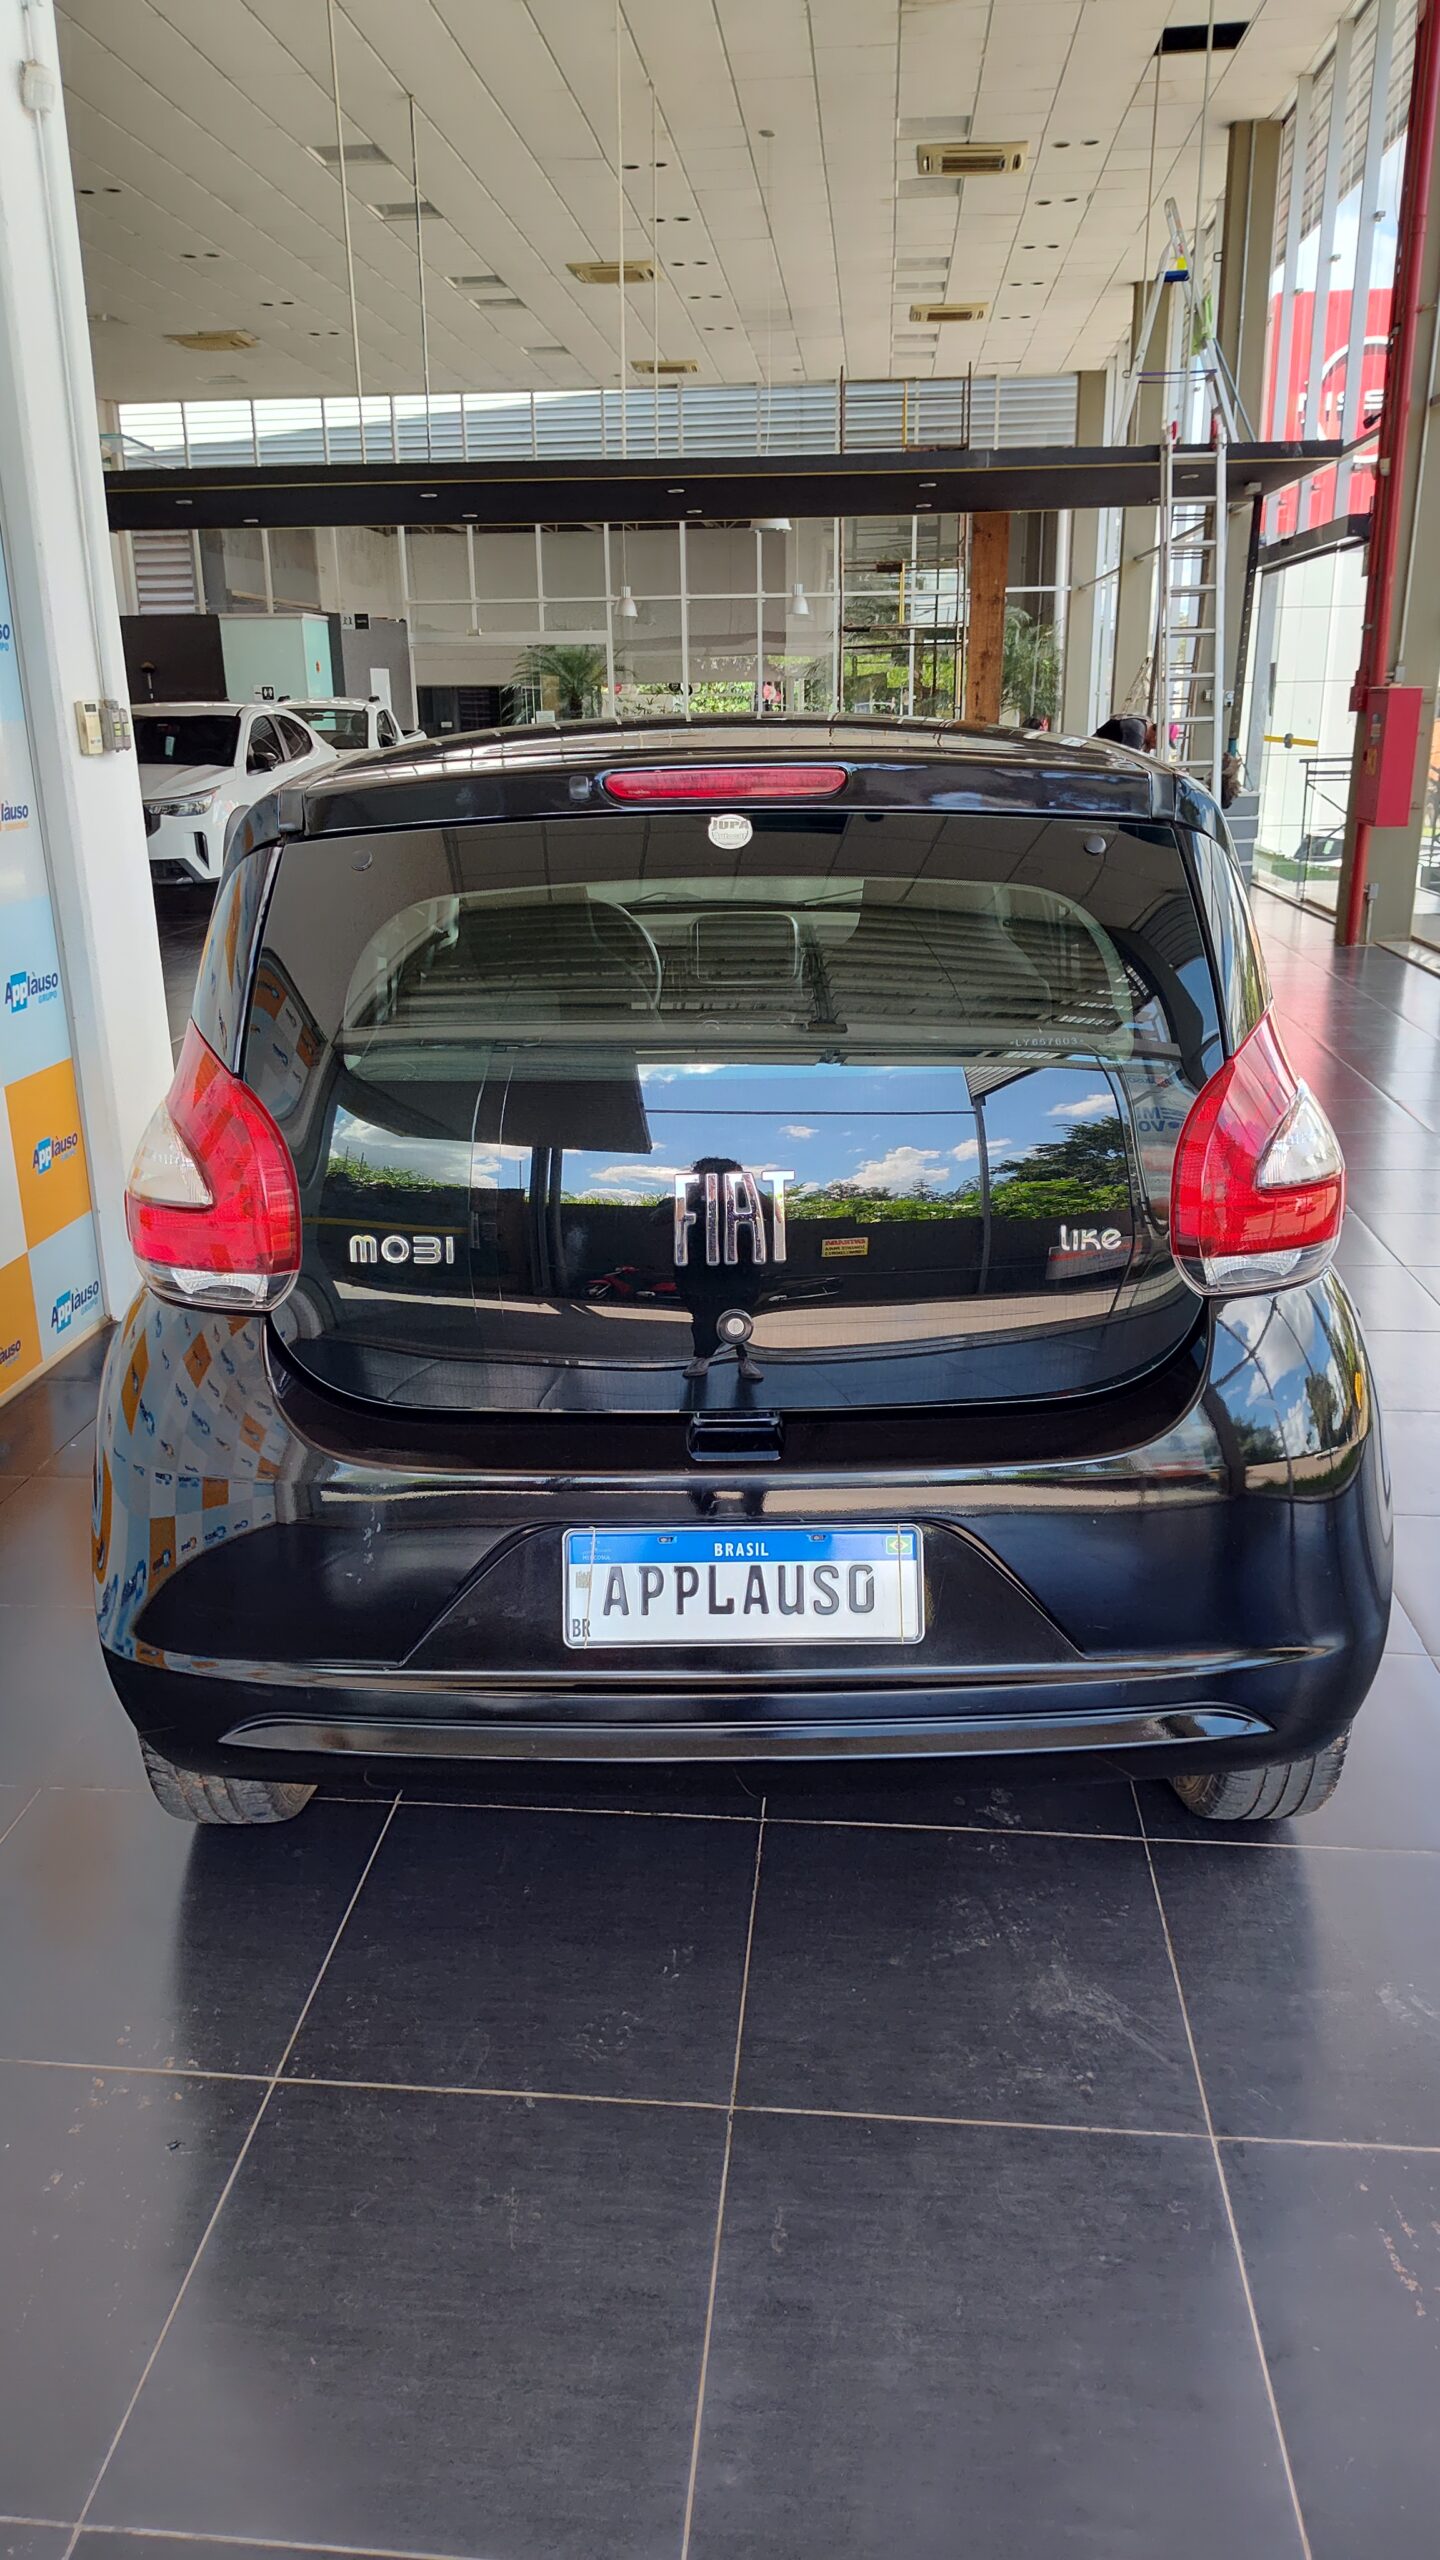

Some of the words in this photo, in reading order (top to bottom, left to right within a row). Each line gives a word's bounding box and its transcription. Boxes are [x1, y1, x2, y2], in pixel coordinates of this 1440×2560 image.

[674, 1170, 795, 1266] FIAT
[349, 1235, 454, 1264] MOBI
[714, 1542, 769, 1557] BRASIL
[602, 1564, 875, 1616] APPLAUSO
[572, 1618, 591, 1637] BR
